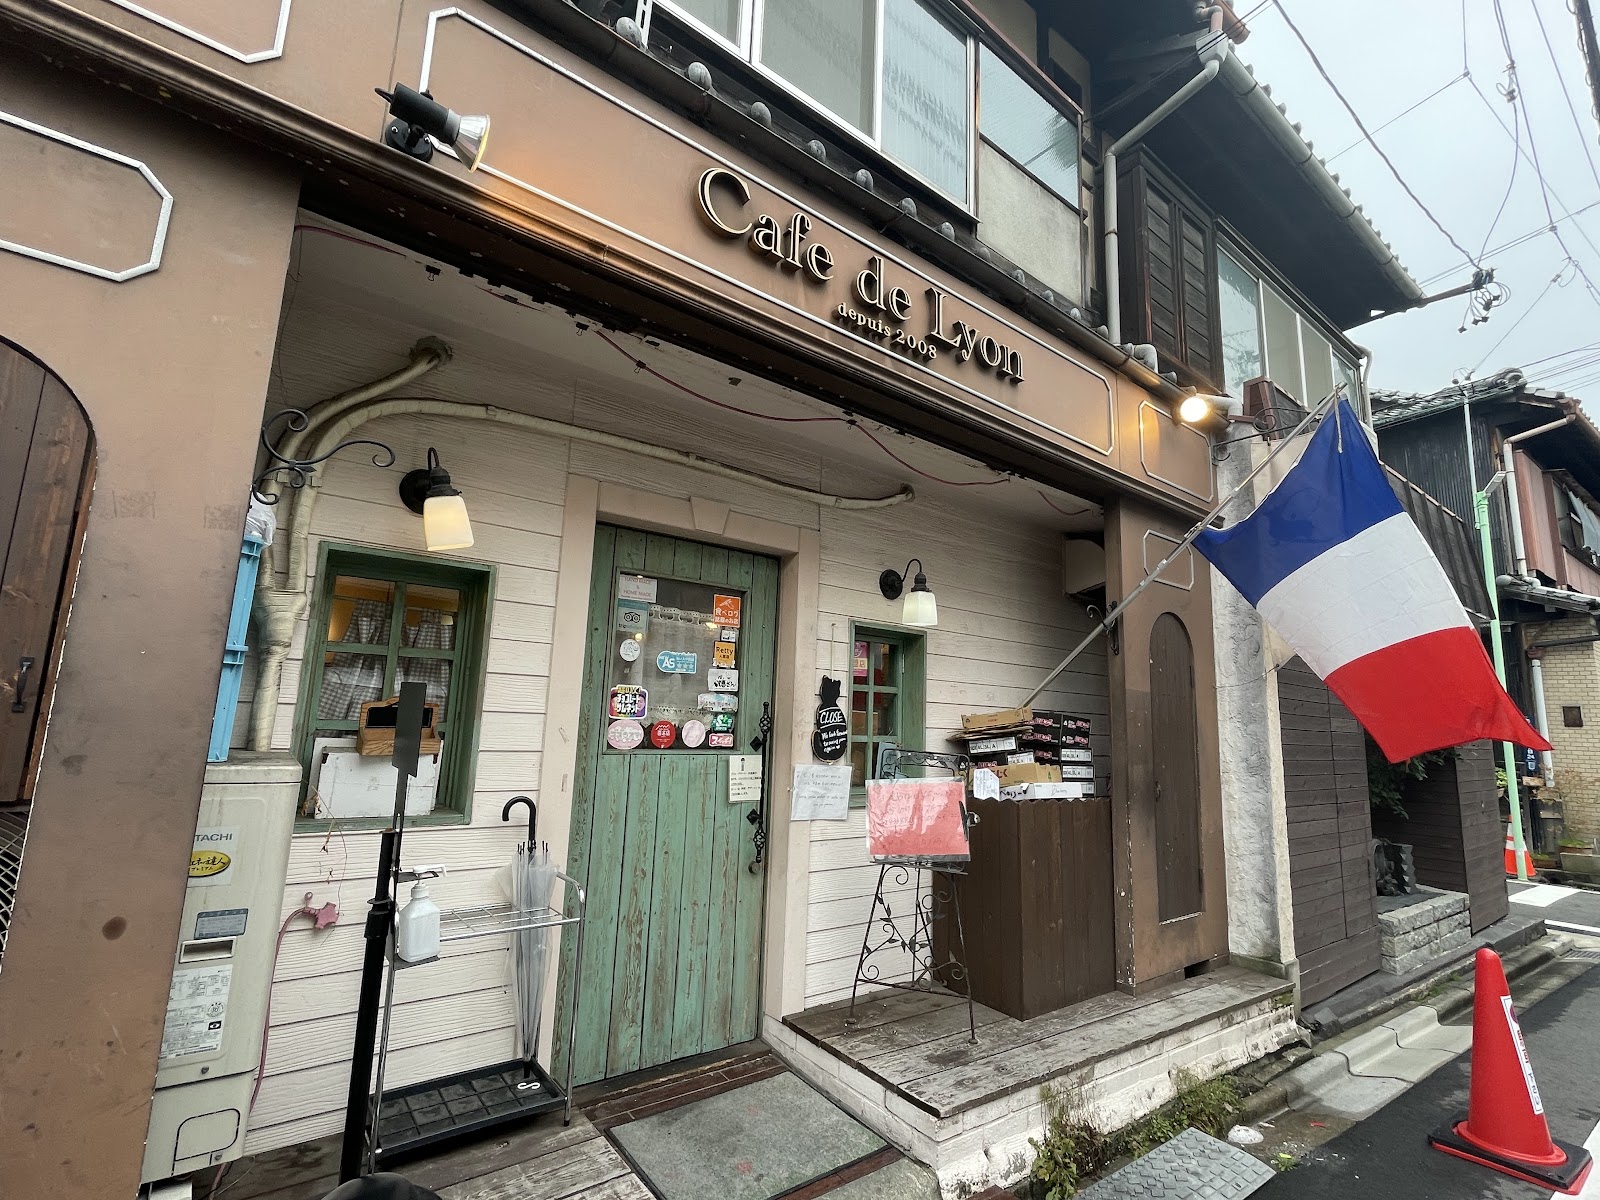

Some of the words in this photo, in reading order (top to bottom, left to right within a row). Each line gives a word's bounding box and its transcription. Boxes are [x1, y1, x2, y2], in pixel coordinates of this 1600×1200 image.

[696, 167, 835, 283] Cafe
[852, 255, 912, 323] de
[925, 286, 1025, 385] Lyon
[836, 302, 892, 338] depuis
[890, 328, 938, 360] 2008
[715, 646, 734, 656] Retty
[820, 711, 843, 724] CLOSE
